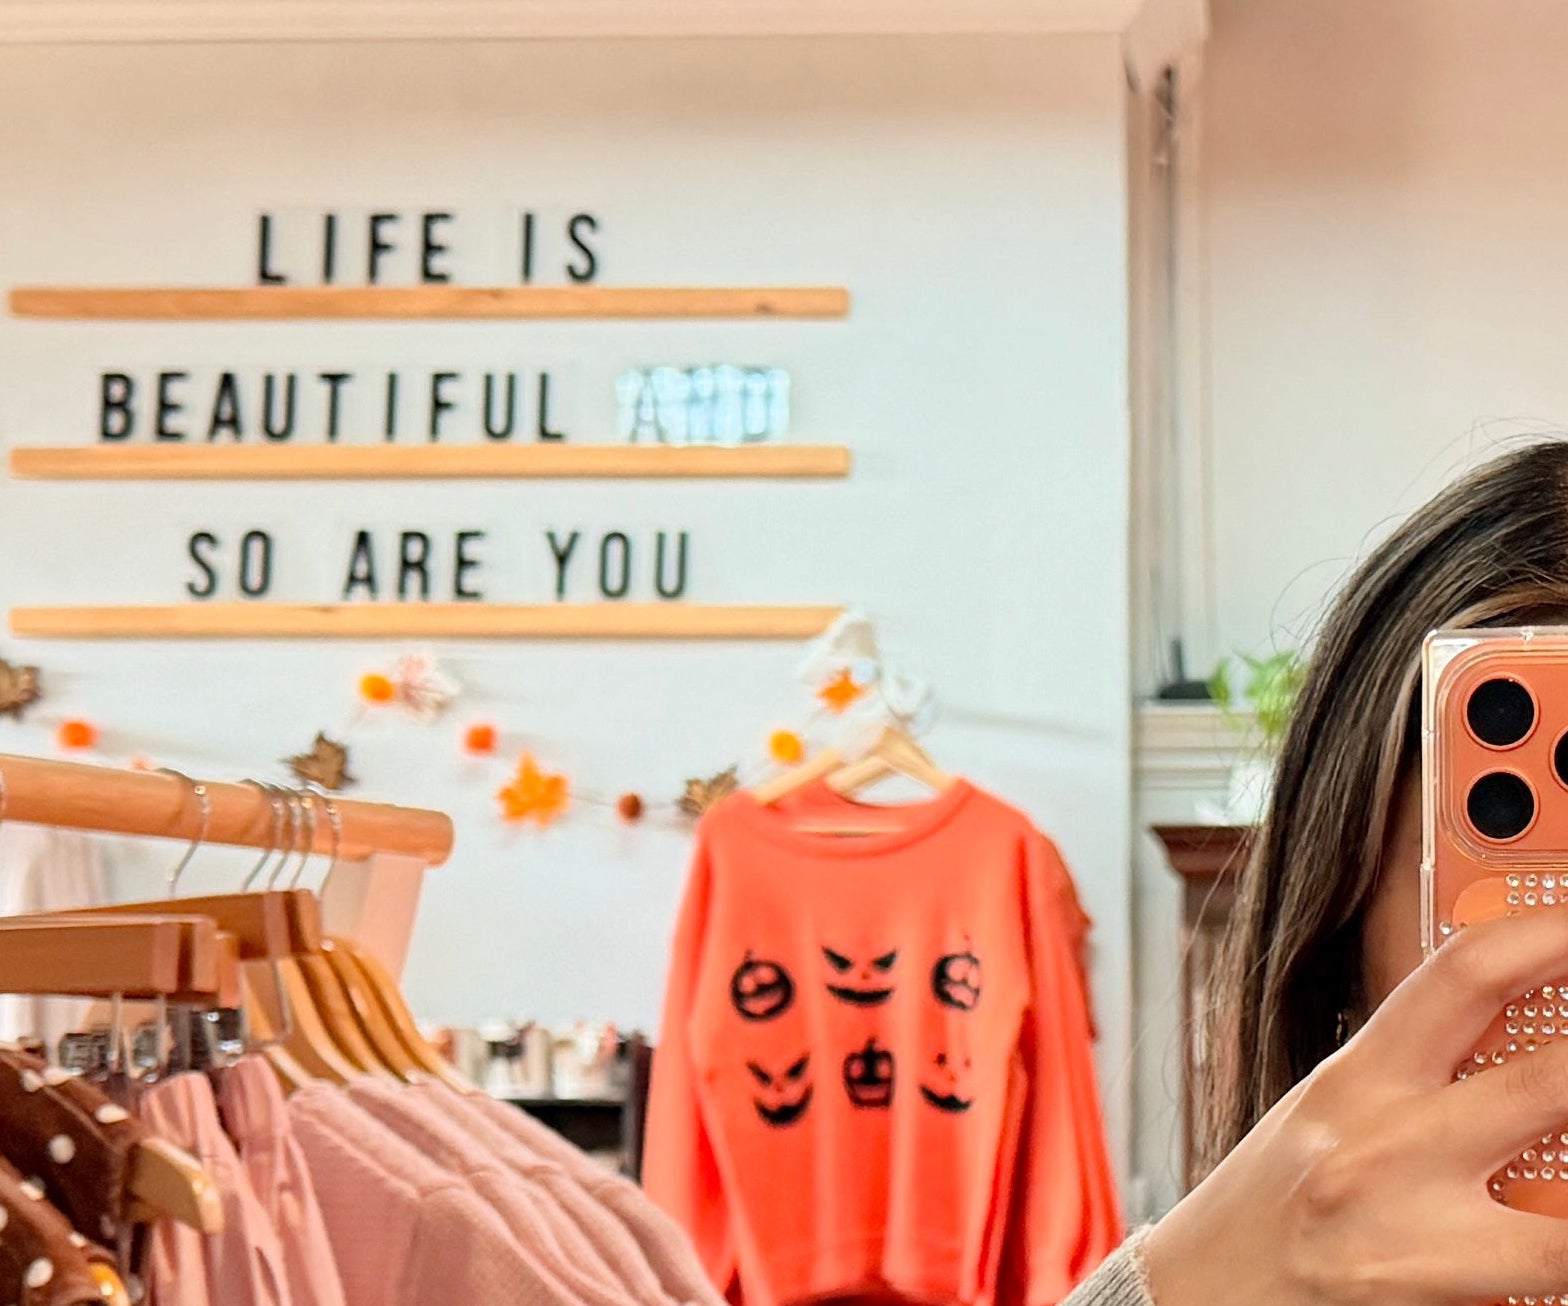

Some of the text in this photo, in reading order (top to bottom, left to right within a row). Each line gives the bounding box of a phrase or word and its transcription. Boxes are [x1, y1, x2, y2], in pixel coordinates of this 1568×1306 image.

[257, 212, 598, 285] LIFE IS
[99, 372, 565, 443] BEAUTIFUL
[187, 530, 688, 600] SO ARE YOU
